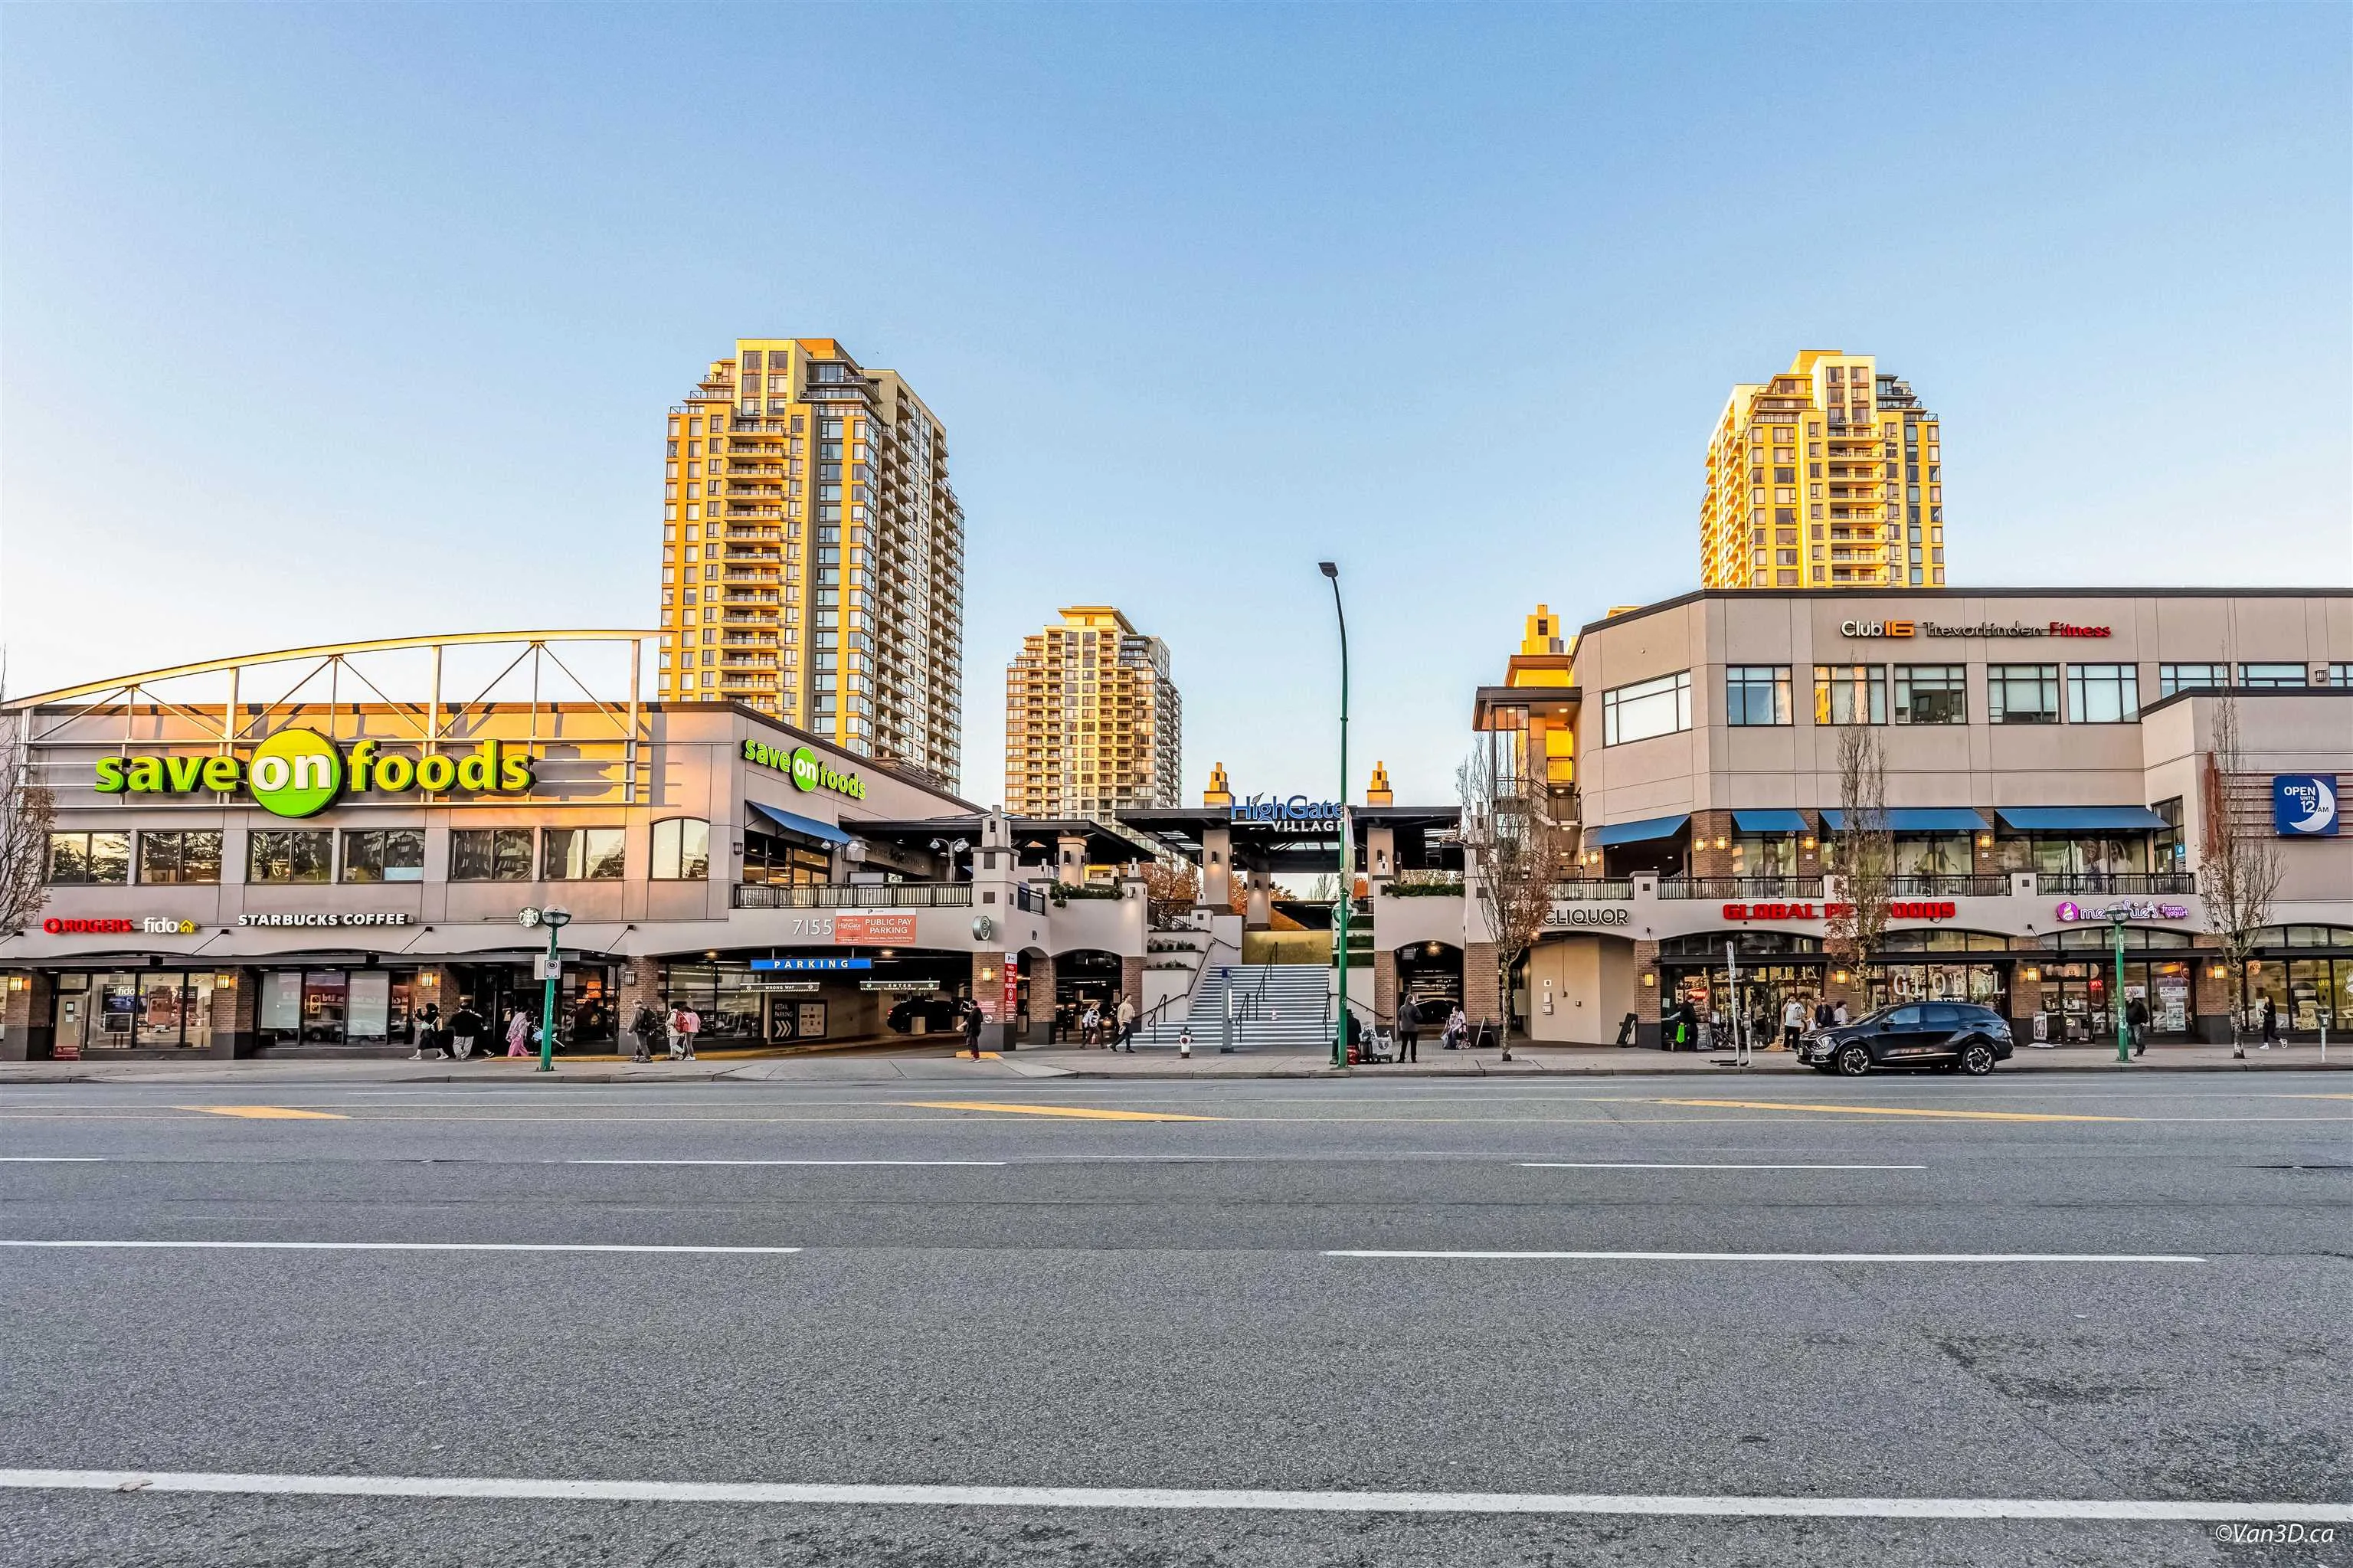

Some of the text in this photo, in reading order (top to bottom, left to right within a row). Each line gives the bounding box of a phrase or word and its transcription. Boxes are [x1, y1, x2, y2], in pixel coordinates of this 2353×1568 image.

[2050, 621, 2112, 638] Fitness
[94, 739, 535, 793] save on foods
[745, 739, 867, 800] save on foods
[2283, 786, 2315, 796] OPEN
[1231, 794, 1342, 821] HighGate
[2301, 800, 2315, 813] 12
[1723, 903, 1818, 919] GLOBAL
[1889, 902, 1955, 918] OODS
[2162, 904, 2183, 912] frozen
[2166, 908, 2188, 918] yogurt
[63, 917, 178, 934] ROGERS fido
[238, 913, 405, 926] STARBUCKS COFFEE
[793, 919, 833, 935] 7155
[774, 960, 849, 968] PARKING
[118, 986, 135, 996] fido
[1893, 971, 2006, 996] GLOBAL
